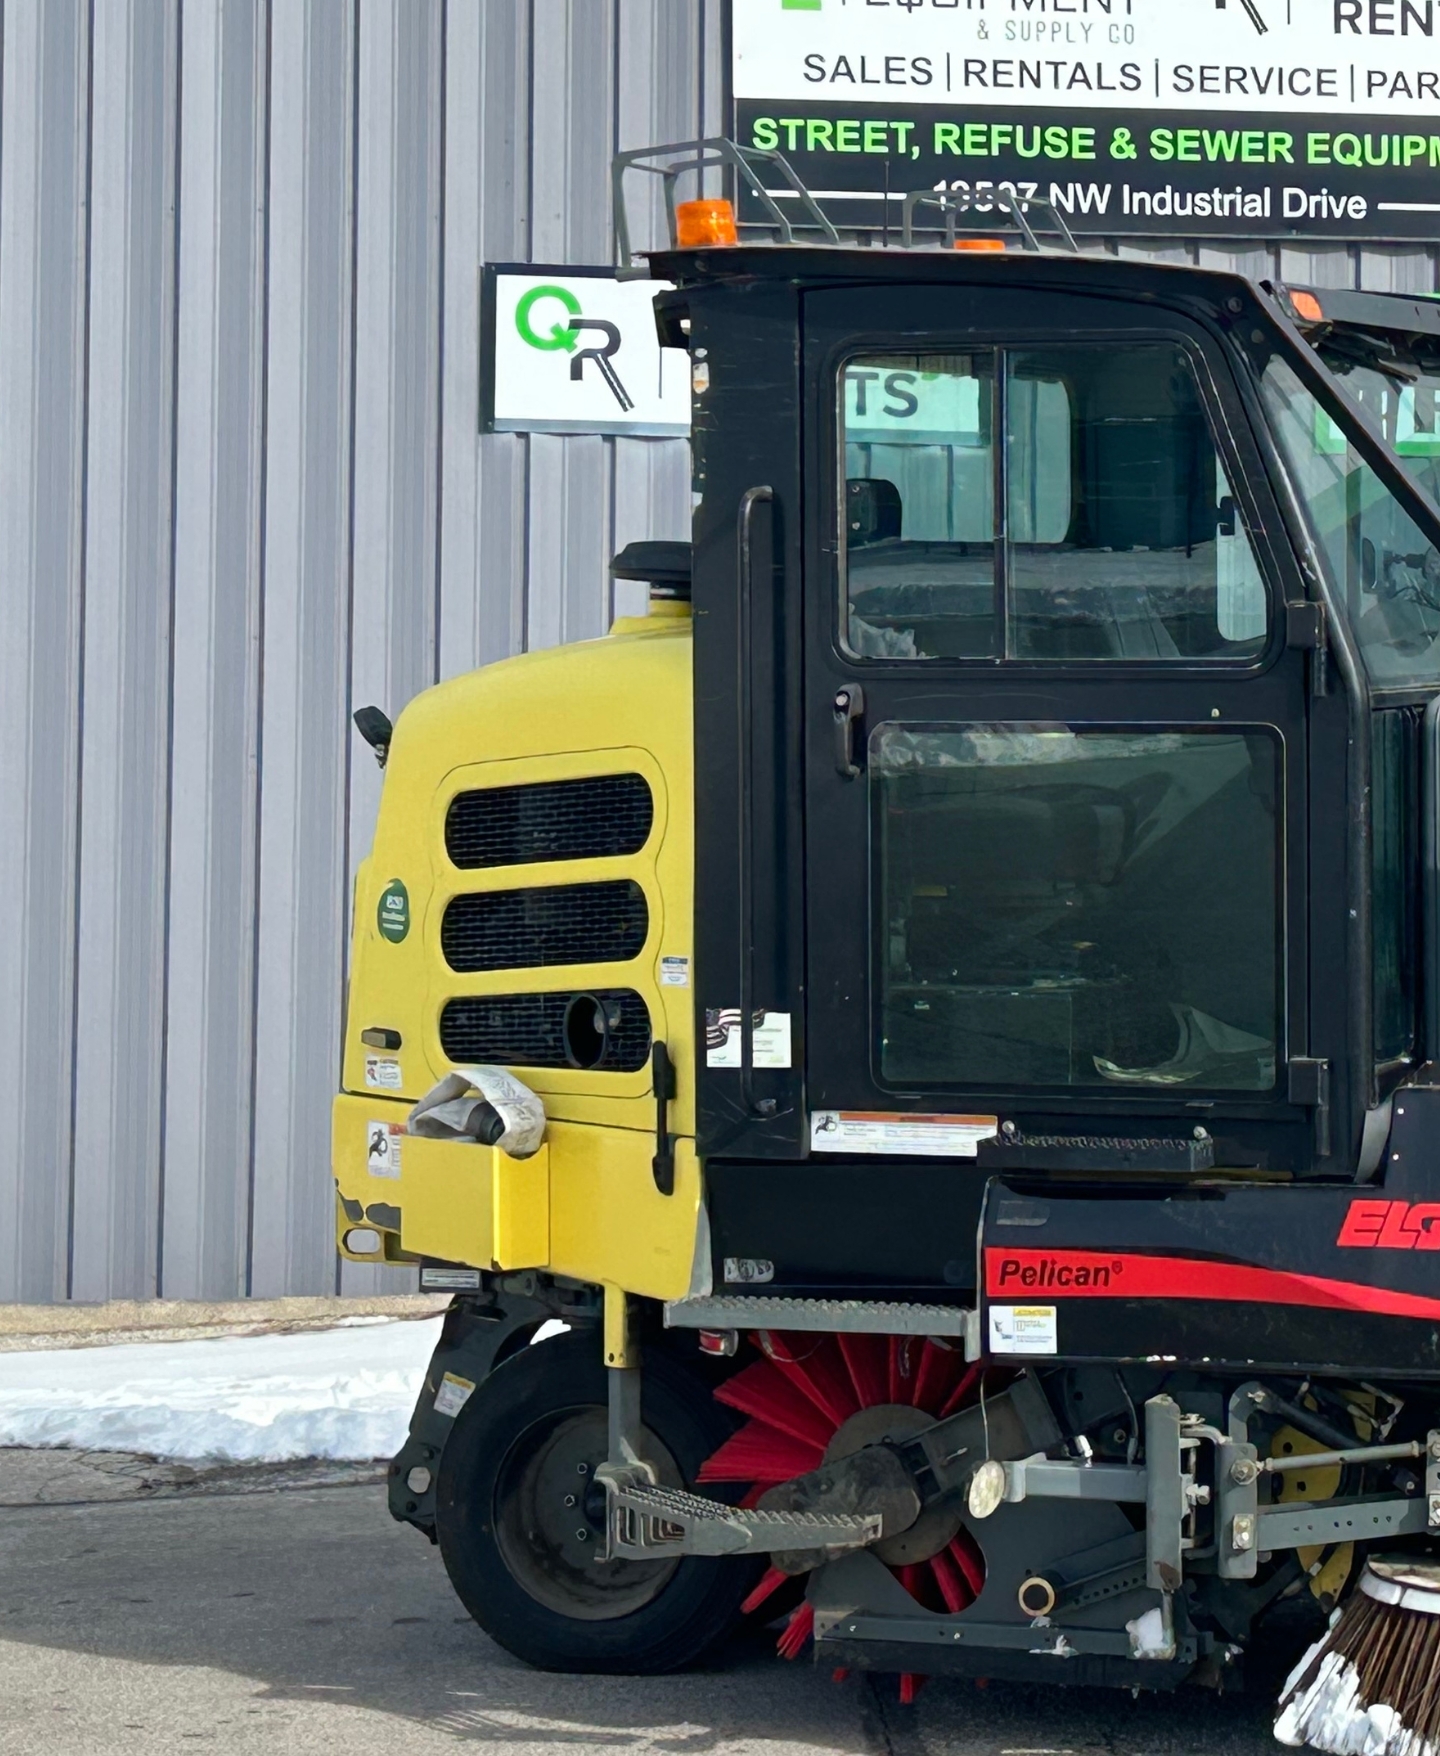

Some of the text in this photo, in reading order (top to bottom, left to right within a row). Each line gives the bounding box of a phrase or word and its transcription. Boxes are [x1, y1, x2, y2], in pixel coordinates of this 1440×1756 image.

[977, 19, 1135, 45] & SUPPLY CO
[803, 53, 934, 87] SALES
[963, 58, 1142, 92] RENTALS
[1171, 63, 1339, 98] SERVICE
[752, 117, 921, 160] STREET,
[933, 122, 1097, 160] REFUSE
[1109, 126, 1138, 160] &
[1149, 128, 1295, 164] SEWER
[1049, 182, 1111, 215] NW
[1121, 183, 1271, 218] Industrial
[1282, 187, 1368, 219] Drive
